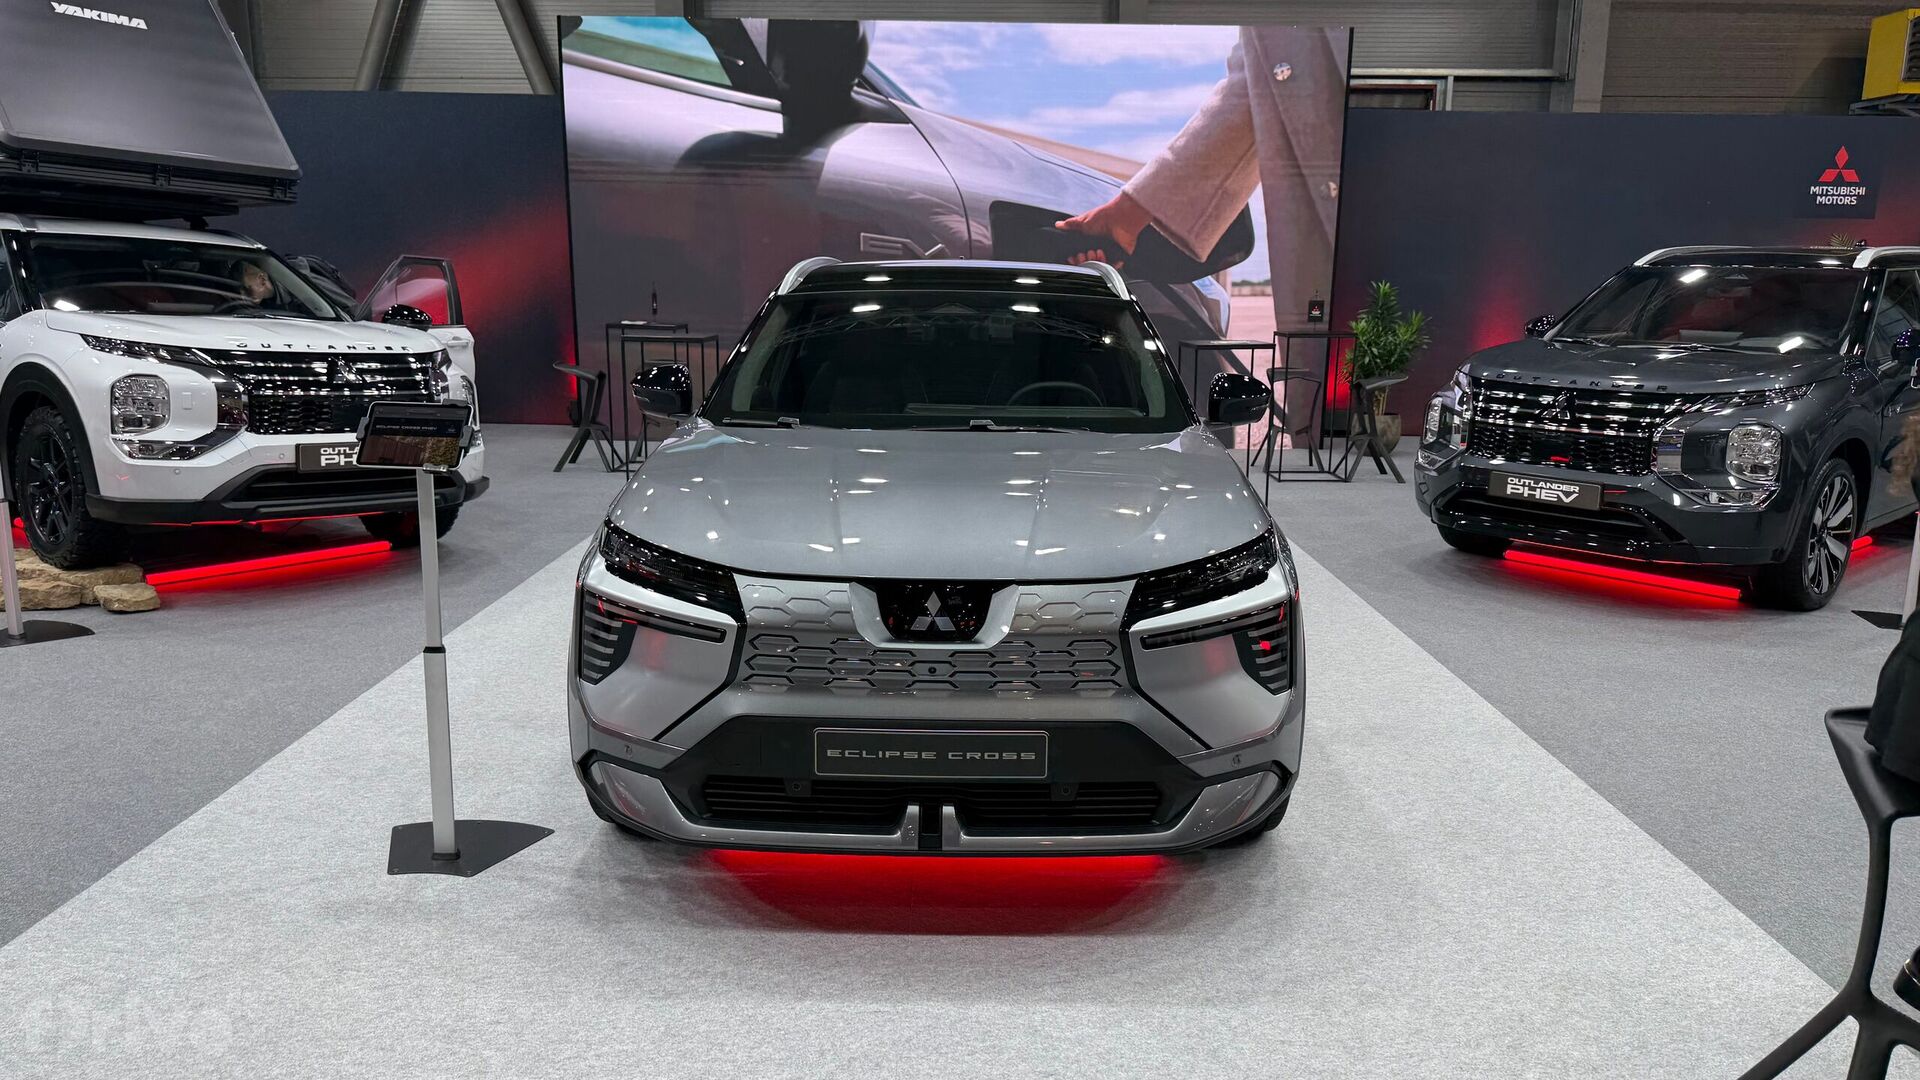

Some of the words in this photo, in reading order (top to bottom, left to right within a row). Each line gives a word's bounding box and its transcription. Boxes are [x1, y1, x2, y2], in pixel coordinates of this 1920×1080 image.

[50, 1, 148, 30] YAKIMA
[1810, 186, 1866, 195] MITSUBISHI
[1816, 196, 1857, 205] MOTORS
[1507, 477, 1580, 493] OUTLANDER
[1506, 484, 1580, 503] PHEV
[826, 749, 937, 760] ECLIPSE
[948, 752, 1036, 760] CROSS
